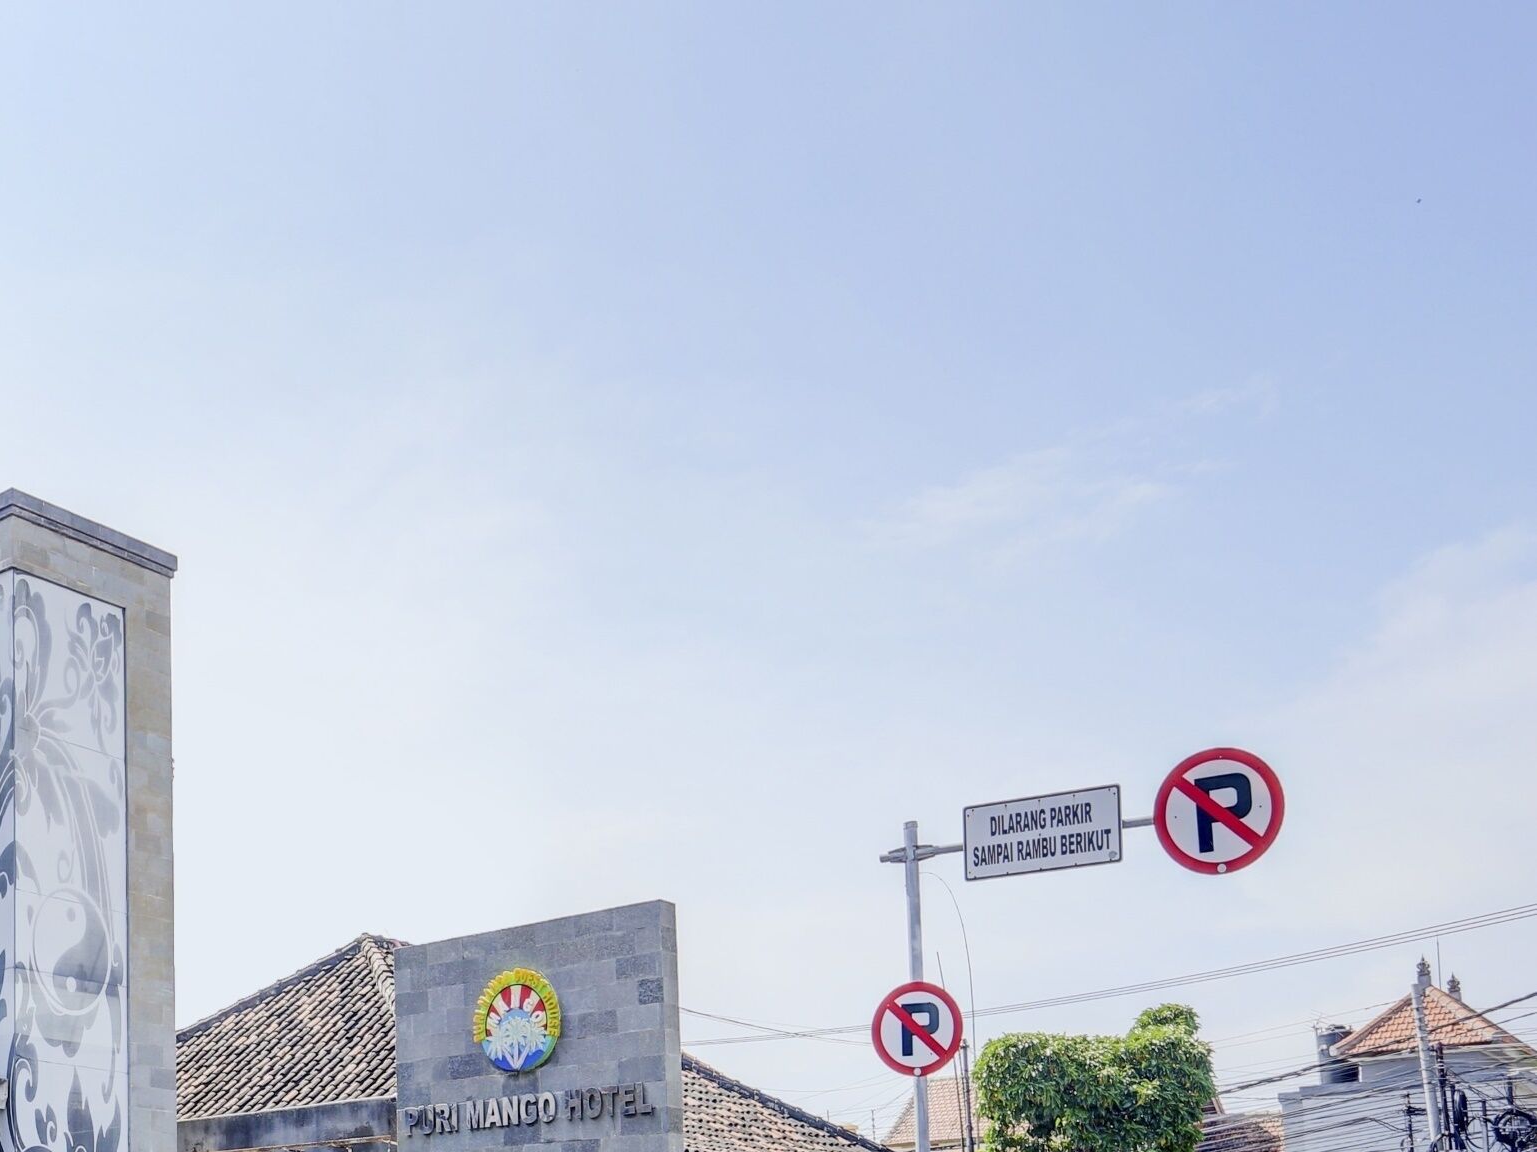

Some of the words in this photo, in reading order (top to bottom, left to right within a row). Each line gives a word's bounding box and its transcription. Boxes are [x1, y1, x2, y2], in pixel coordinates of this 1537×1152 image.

[990, 808, 1046, 837] DILARANG
[1050, 802, 1093, 828] PARKIR
[973, 842, 1014, 867] SAMPAI
[1017, 836, 1057, 861] RAMBU
[1061, 828, 1112, 856] BERIKUT
[405, 1103, 460, 1137] PURI
[466, 1091, 557, 1131] MANGO
[567, 1081, 655, 1122] HOTEL
